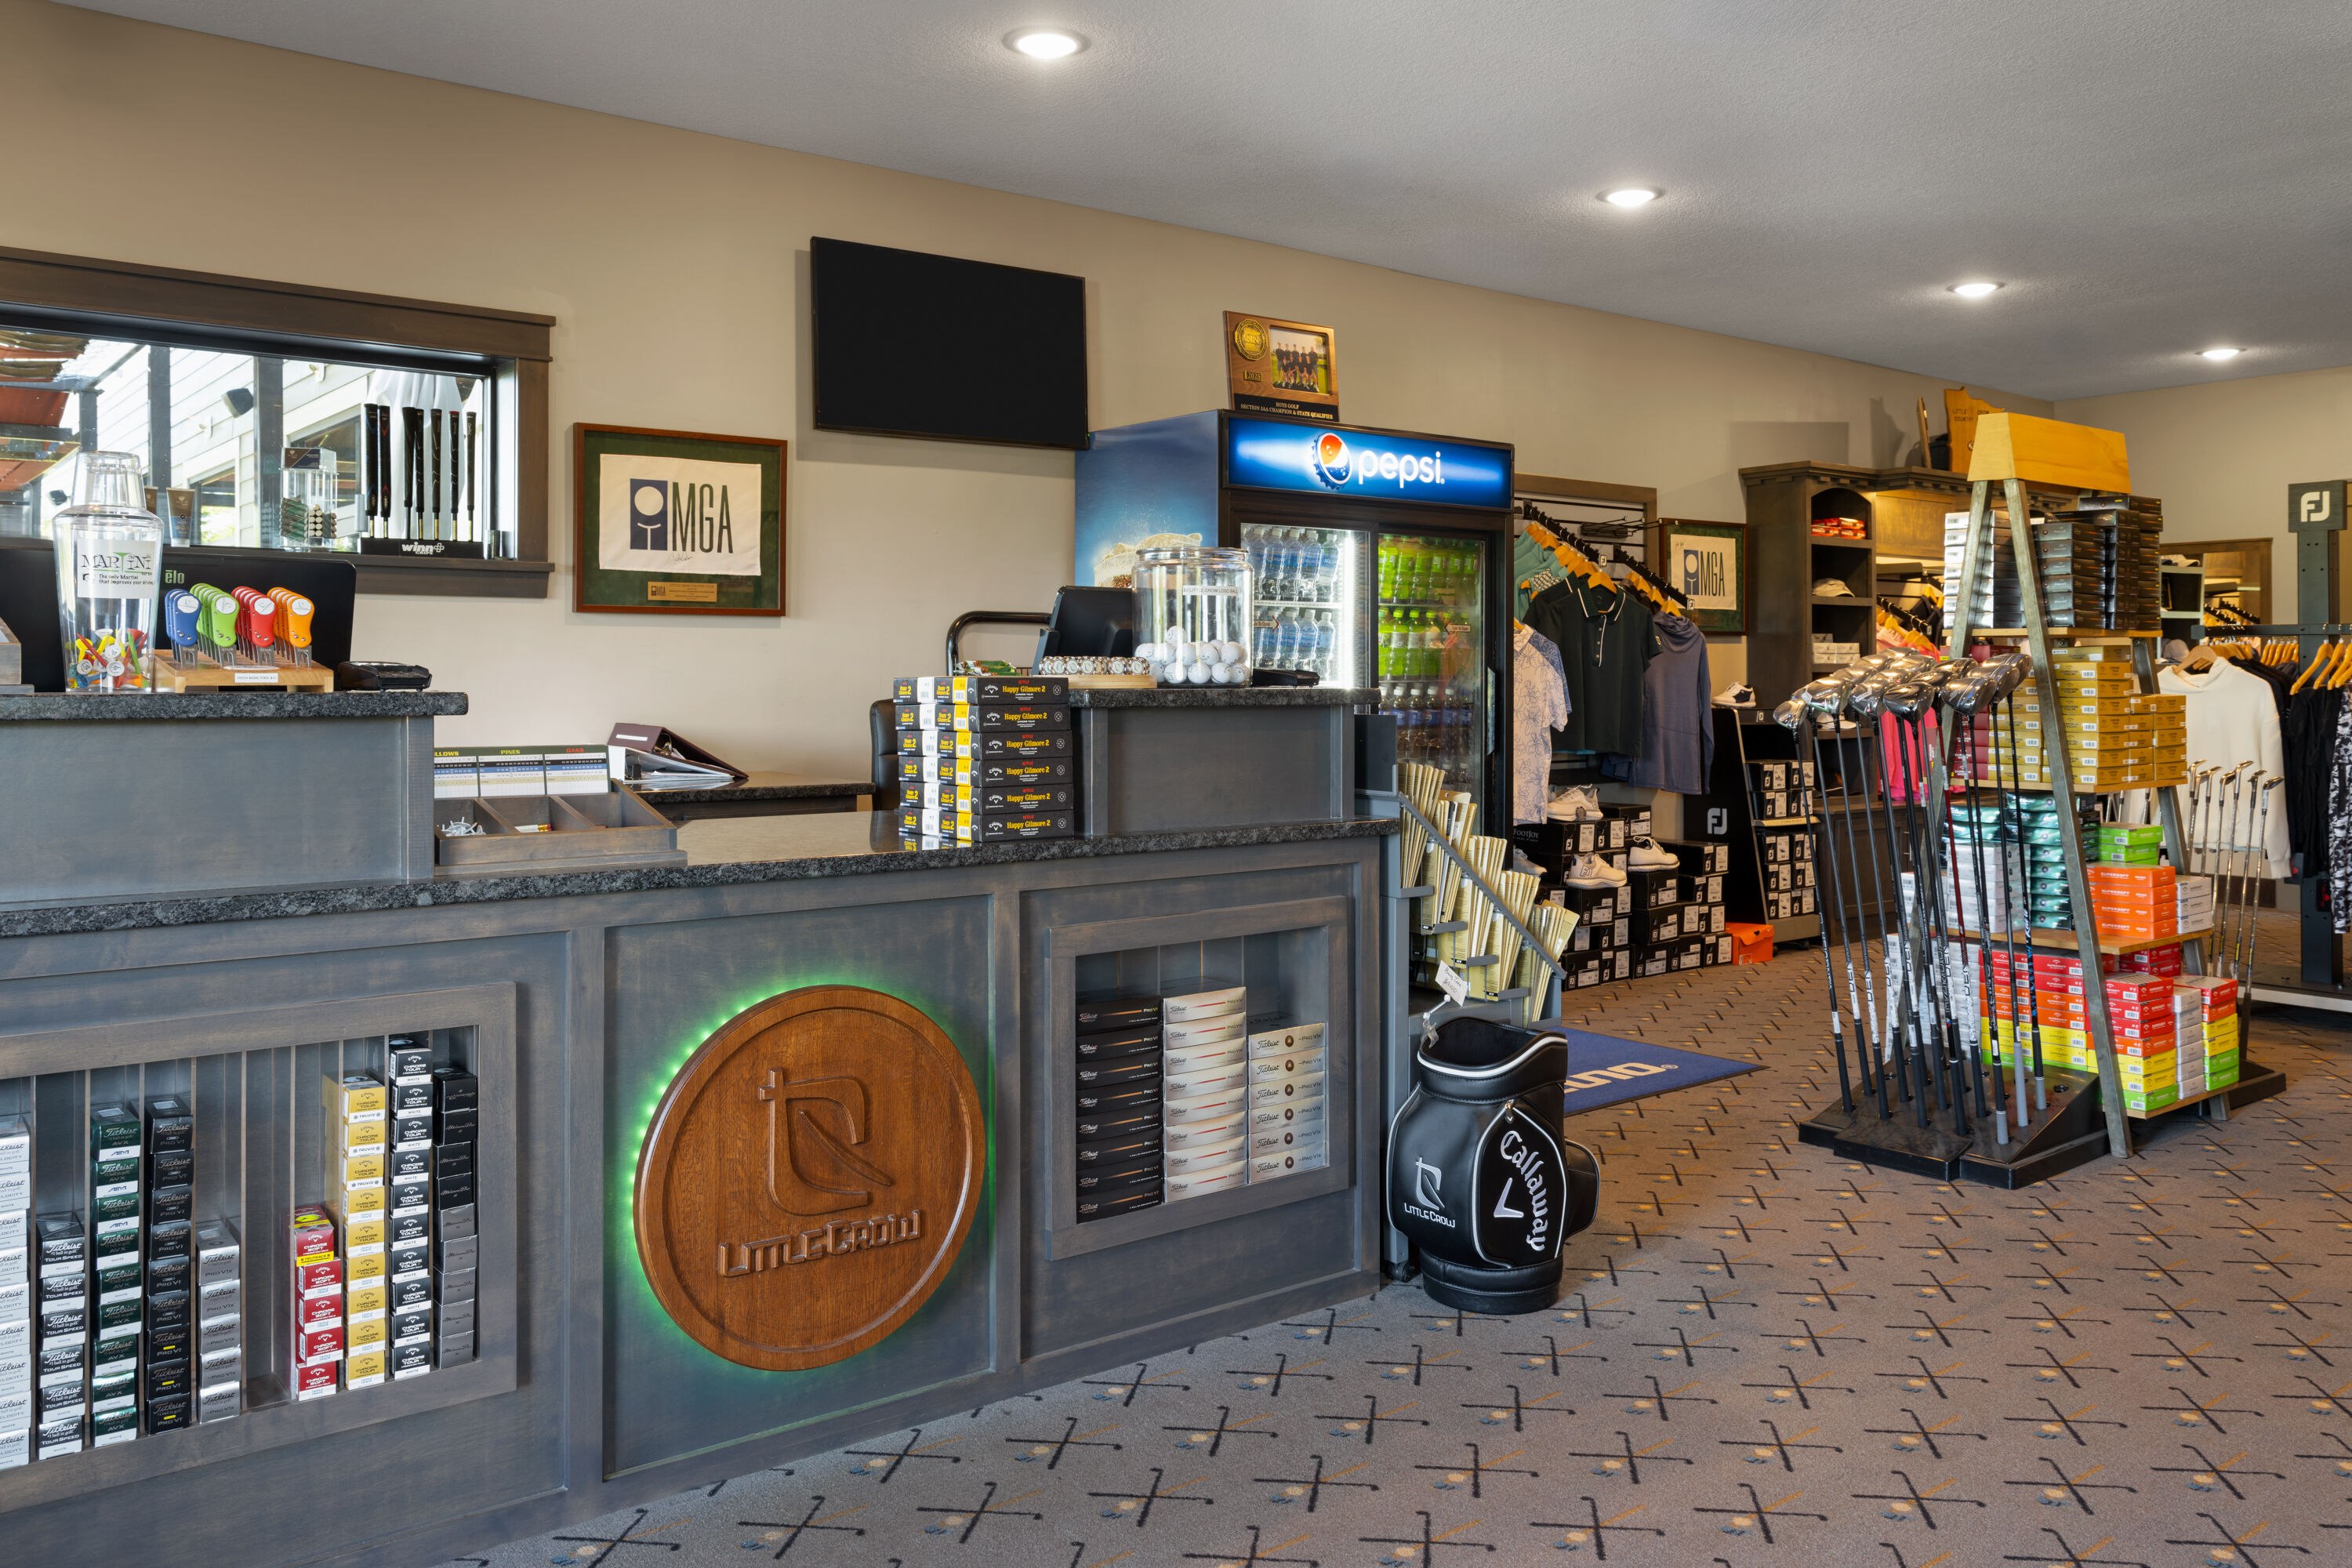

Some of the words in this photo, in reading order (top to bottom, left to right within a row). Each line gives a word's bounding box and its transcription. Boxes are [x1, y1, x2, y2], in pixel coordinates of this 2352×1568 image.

[1247, 372, 1261, 381] 2025
[1358, 450, 1442, 488] pepsi
[2300, 490, 2331, 523] FJ
[672, 481, 734, 554] MGA
[401, 541, 434, 552] winn
[1700, 551, 1726, 597] MGA
[1707, 808, 1728, 835] FJ
[1256, 1040, 1279, 1051] Titleist
[1256, 1064, 1279, 1075] Titleist
[1564, 1062, 1667, 1094] UNO
[103, 1127, 137, 1138] Titleist
[157, 1123, 191, 1134] Titleist
[1500, 1130, 1548, 1251] Callaway
[154, 1229, 188, 1240] Titleist
[46, 1243, 82, 1254] Titleist
[203, 1254, 234, 1265] Titleist
[49, 1314, 82, 1327] Titleist
[153, 1332, 186, 1344] Titleist
[99, 1411, 133, 1424] Titleist
[43, 1422, 78, 1436] Titleist
